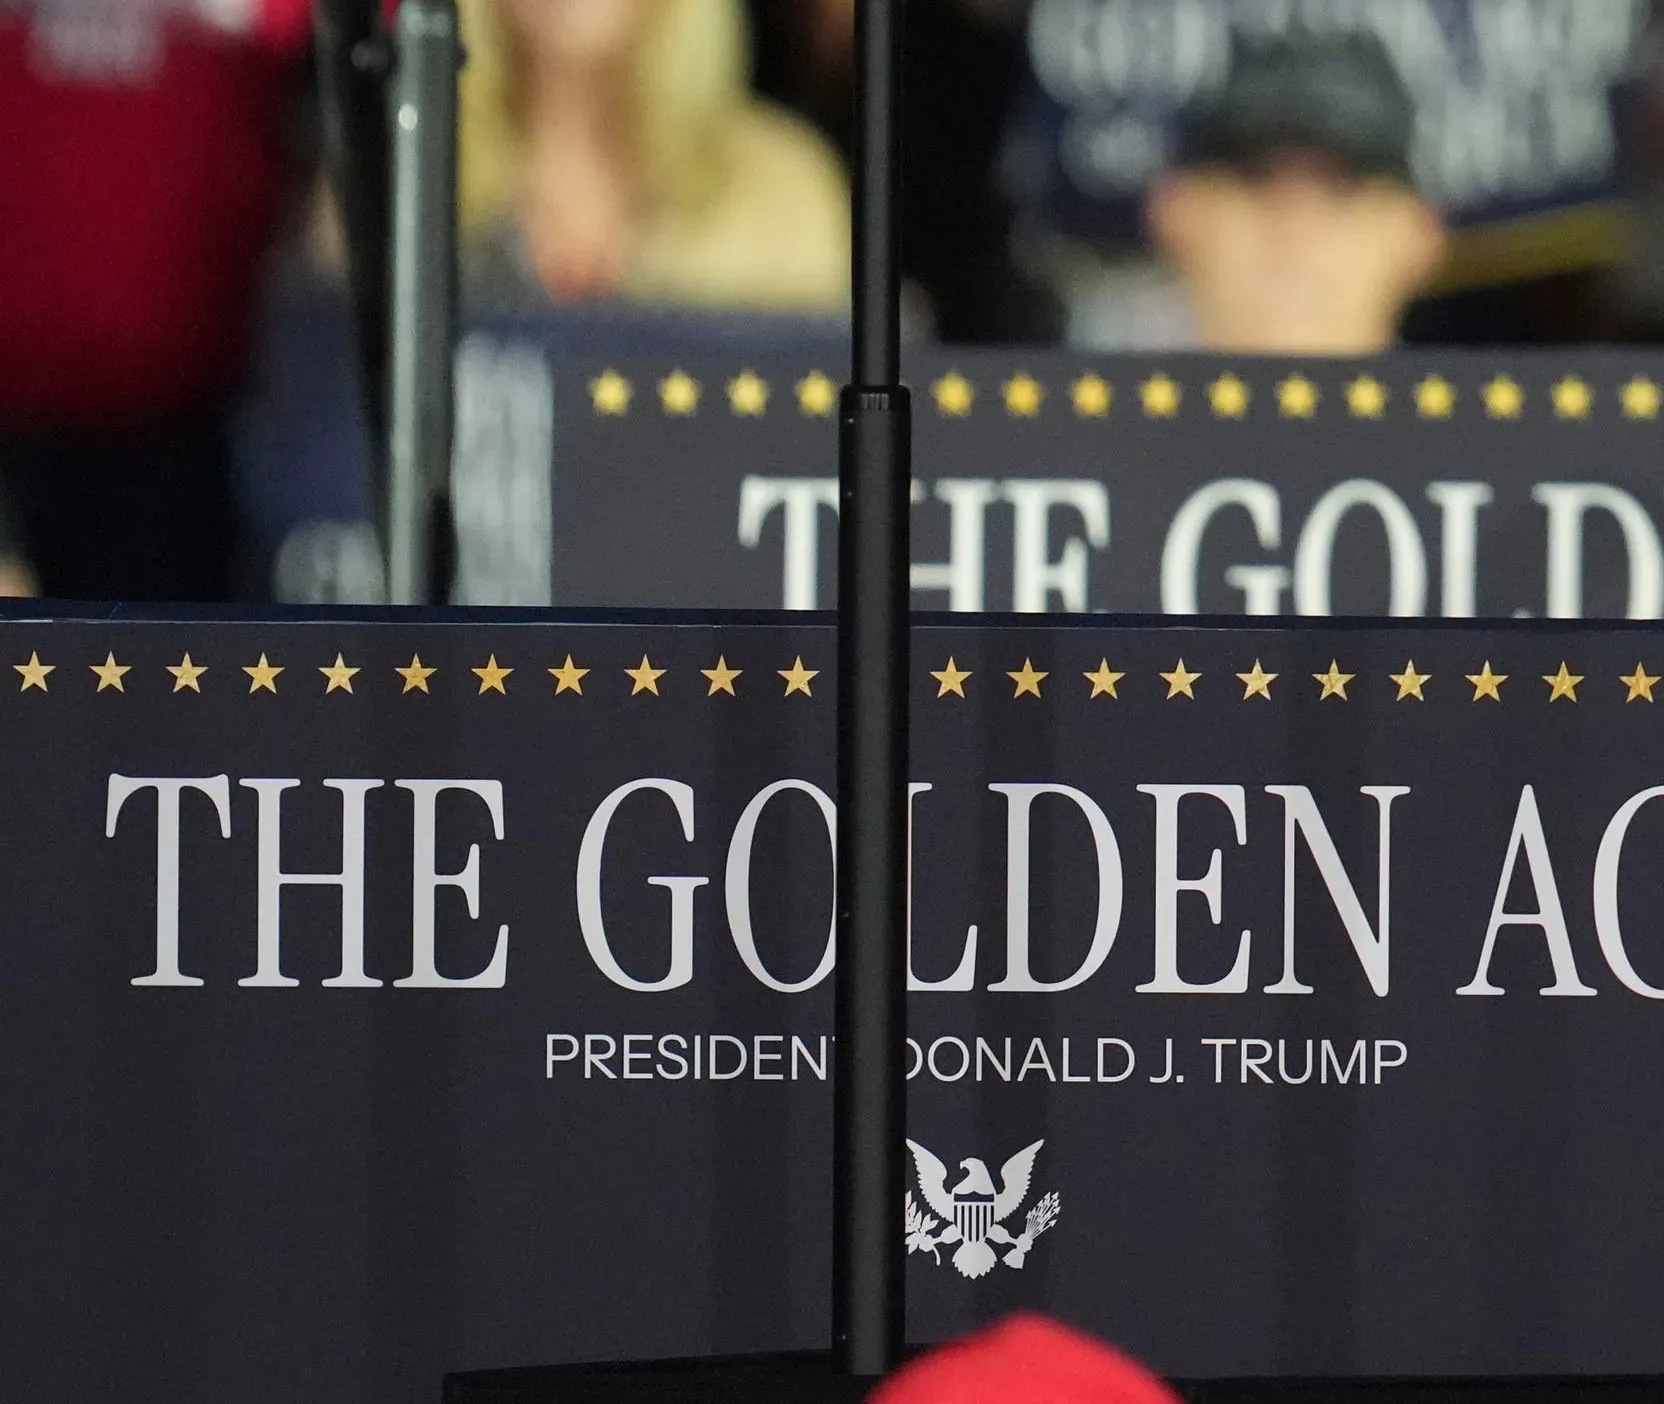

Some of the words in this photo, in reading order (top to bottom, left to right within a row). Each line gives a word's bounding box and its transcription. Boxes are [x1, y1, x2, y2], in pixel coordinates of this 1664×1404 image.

[106, 774, 508, 988] THE
[577, 778, 1410, 997] GOLDEN
[547, 1034, 826, 1080] PRESIDEN
[1150, 1039, 1183, 1083] J.
[1201, 1039, 1407, 1084] TRUMP
